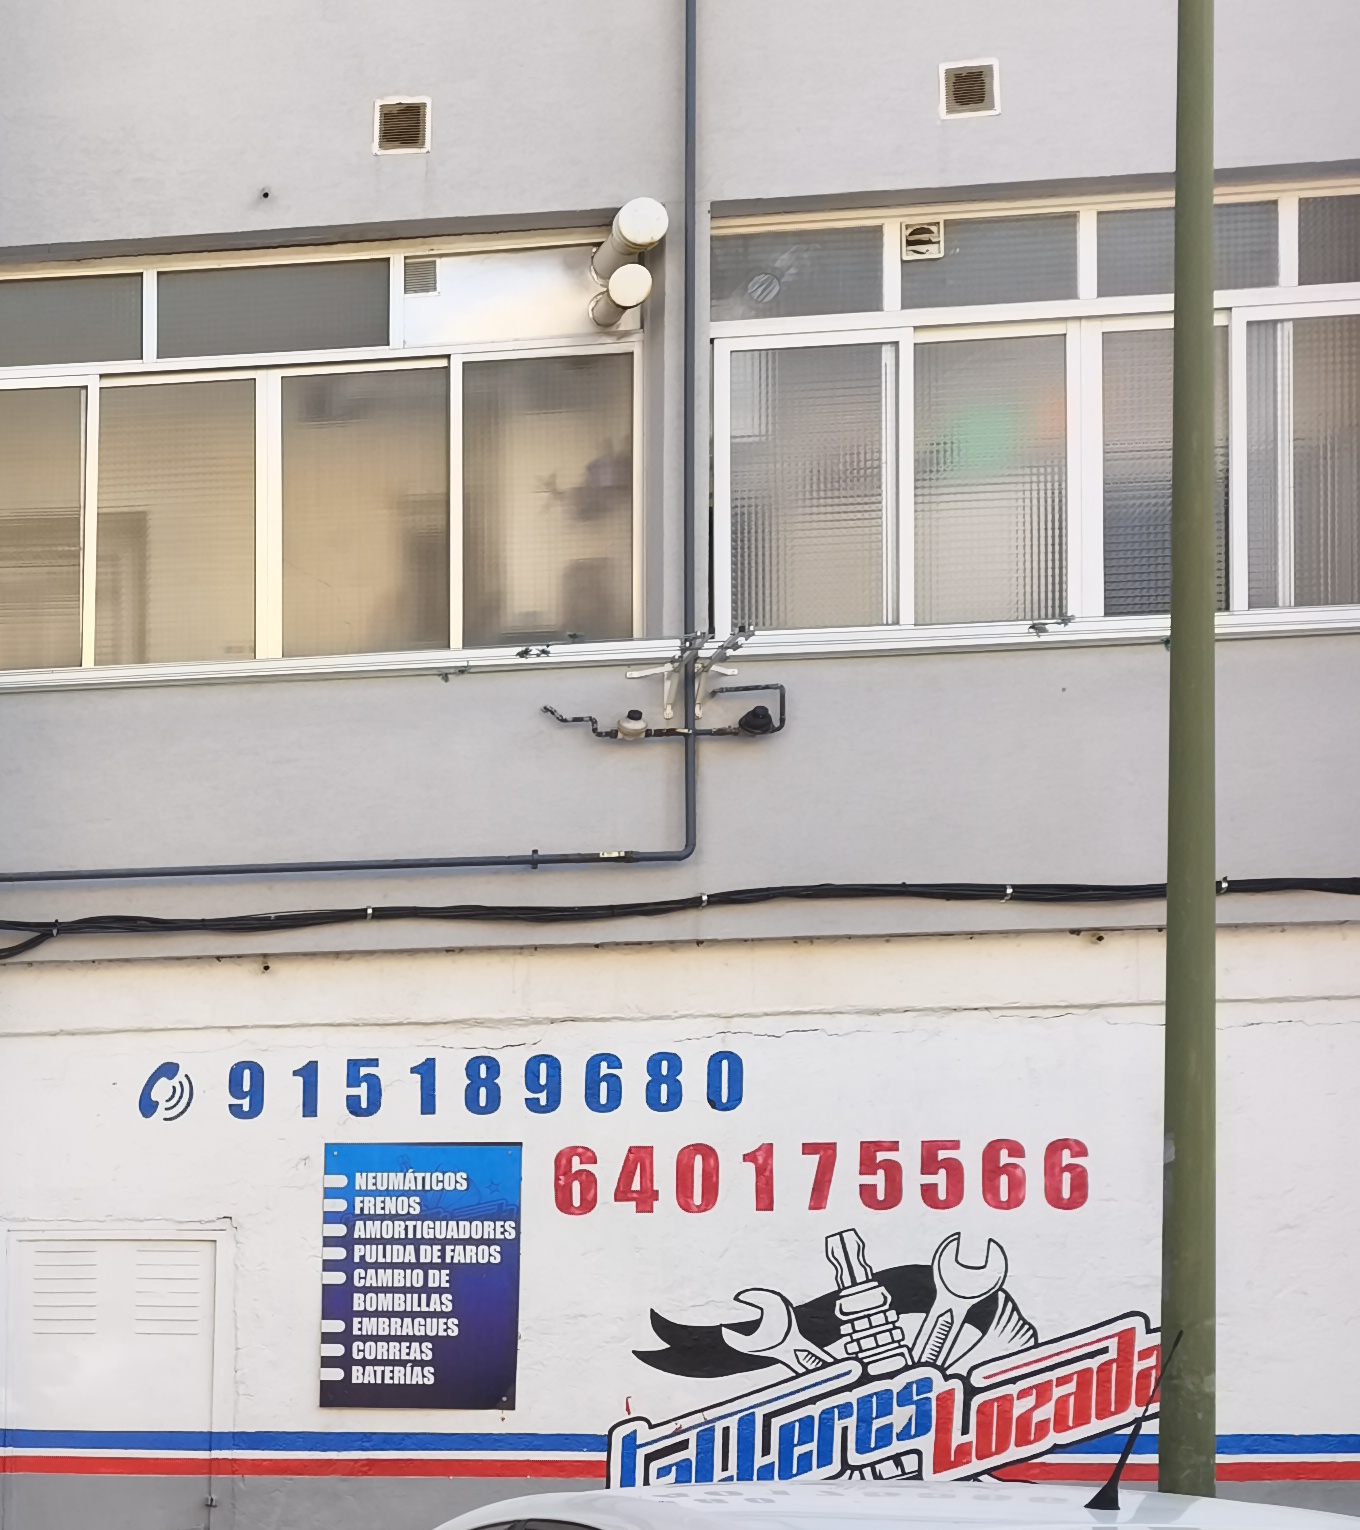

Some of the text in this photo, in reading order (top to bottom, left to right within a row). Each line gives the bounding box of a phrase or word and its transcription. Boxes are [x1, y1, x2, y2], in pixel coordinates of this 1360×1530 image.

[227, 1050, 745, 1121] 915189680
[355, 1169, 468, 1191] NEUMÁTICOS
[553, 1138, 1089, 1215] 640175566
[354, 1196, 420, 1215] FRENOS
[353, 1220, 516, 1239] AMORTIGUADORES
[353, 1245, 501, 1264] PULIDA DE FAROS
[353, 1269, 450, 1288] CAMBIO DE
[352, 1293, 453, 1312] BOMBILLAS
[352, 1317, 459, 1336] EMBRAGUES
[351, 1341, 433, 1360] CORREAS
[351, 1363, 435, 1385] BATERÍAS
